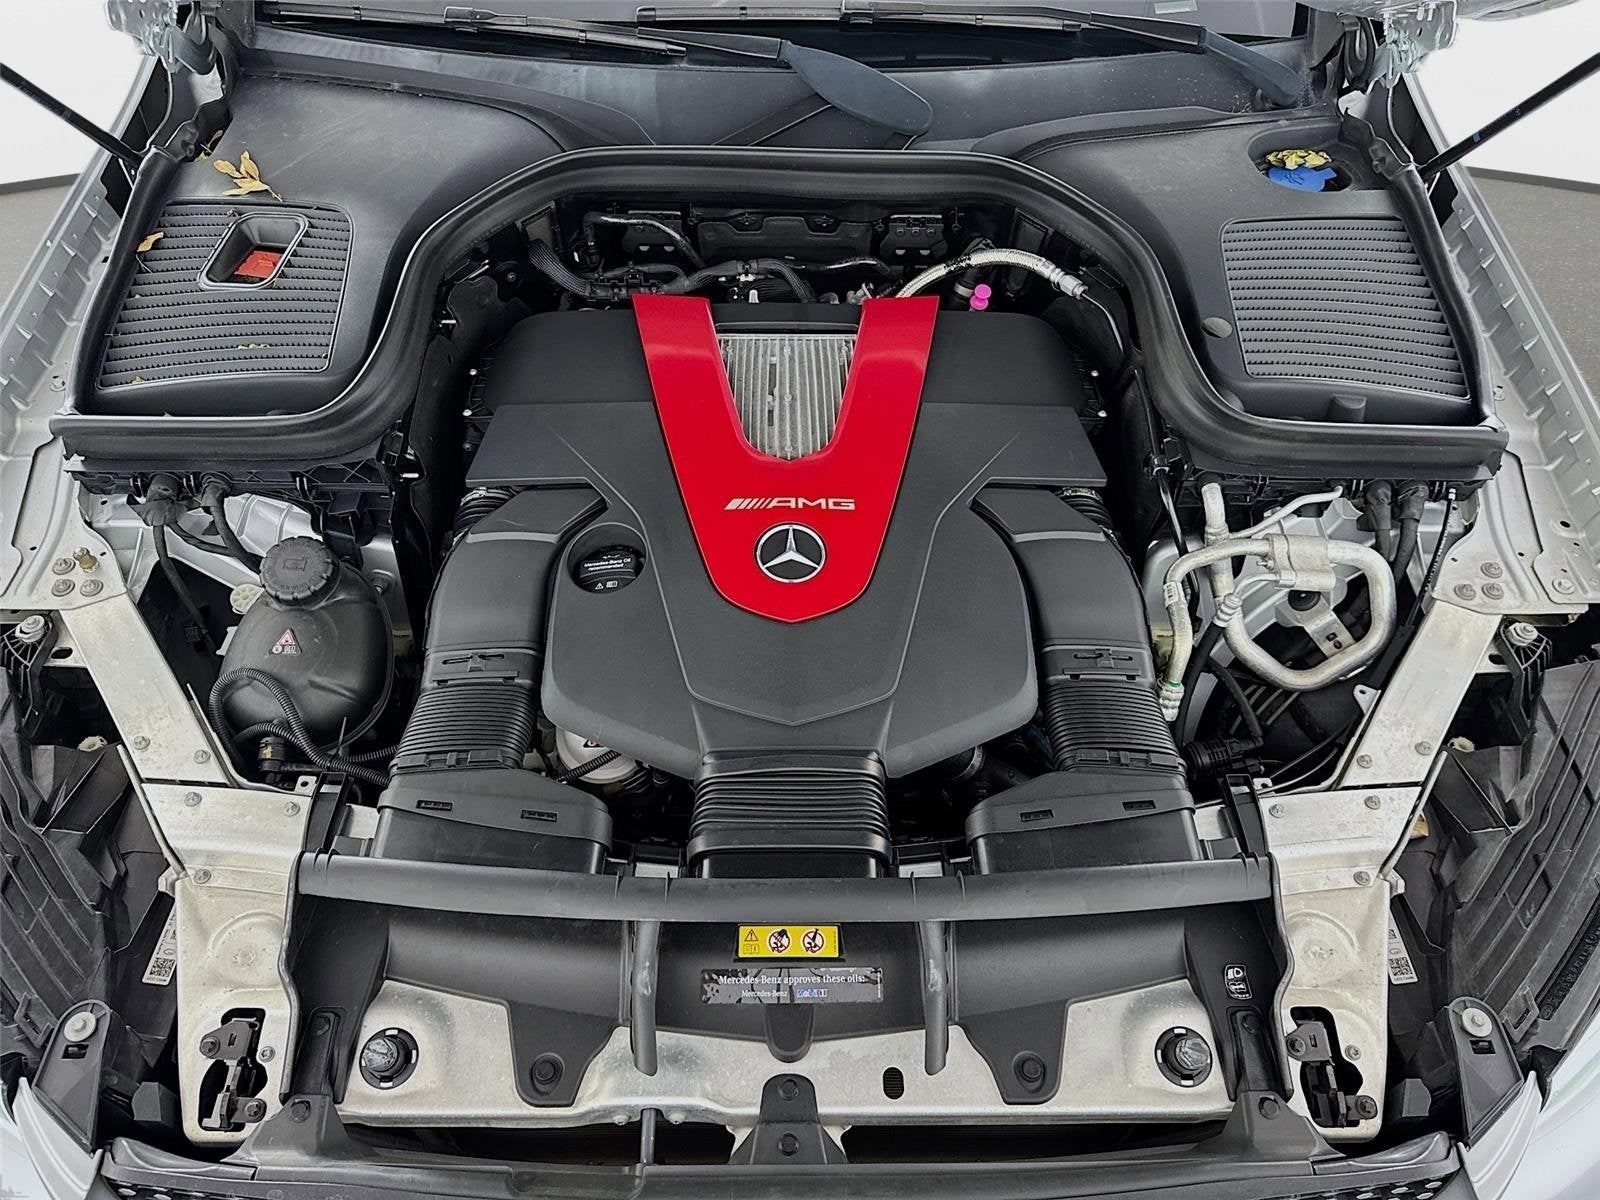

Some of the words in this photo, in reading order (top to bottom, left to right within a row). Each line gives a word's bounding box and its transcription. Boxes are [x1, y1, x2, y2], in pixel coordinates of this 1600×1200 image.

[766, 497, 855, 510] AMG
[719, 975, 782, 985] Mercedes-Benz
[783, 976, 821, 986] approves
[823, 974, 846, 984] these
[847, 974, 865, 984] oils:
[742, 989, 788, 998] Mercedes-Benz
